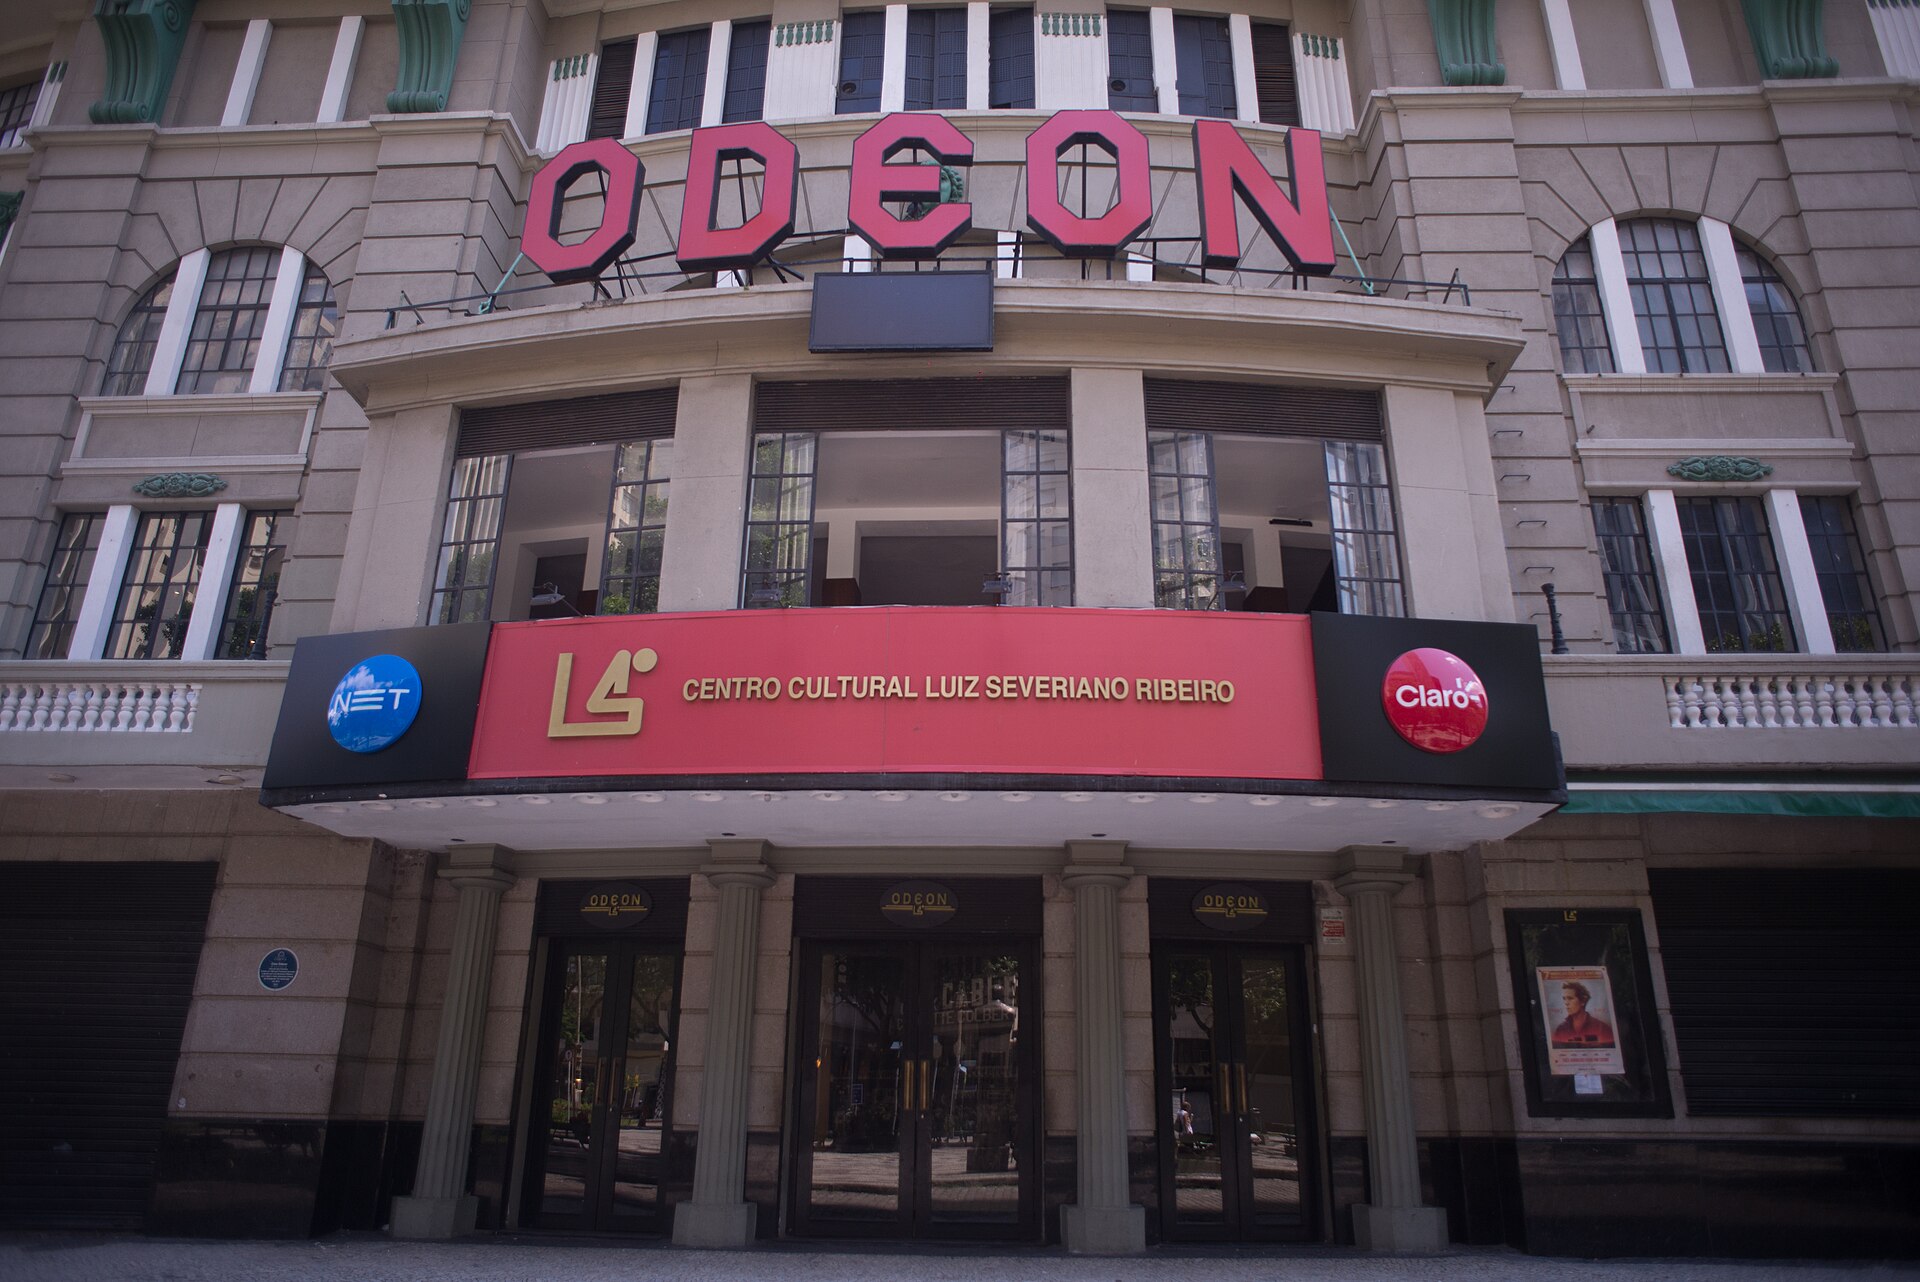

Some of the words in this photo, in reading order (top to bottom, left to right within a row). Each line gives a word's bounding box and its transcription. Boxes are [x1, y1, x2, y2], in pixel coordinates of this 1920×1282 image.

[521, 110, 1336, 285] ODEON
[334, 689, 410, 714] NET
[682, 677, 781, 702] CENTRO
[788, 676, 918, 699] CULTURAL
[926, 676, 980, 698] LUIZ
[985, 676, 1129, 700] SEVERIANO
[1136, 679, 1235, 703] RIBEIRO
[1396, 682, 1471, 709] Claro
[590, 895, 641, 906] ODEON
[892, 893, 947, 905] ODEON
[1204, 895, 1259, 908] ODEON
